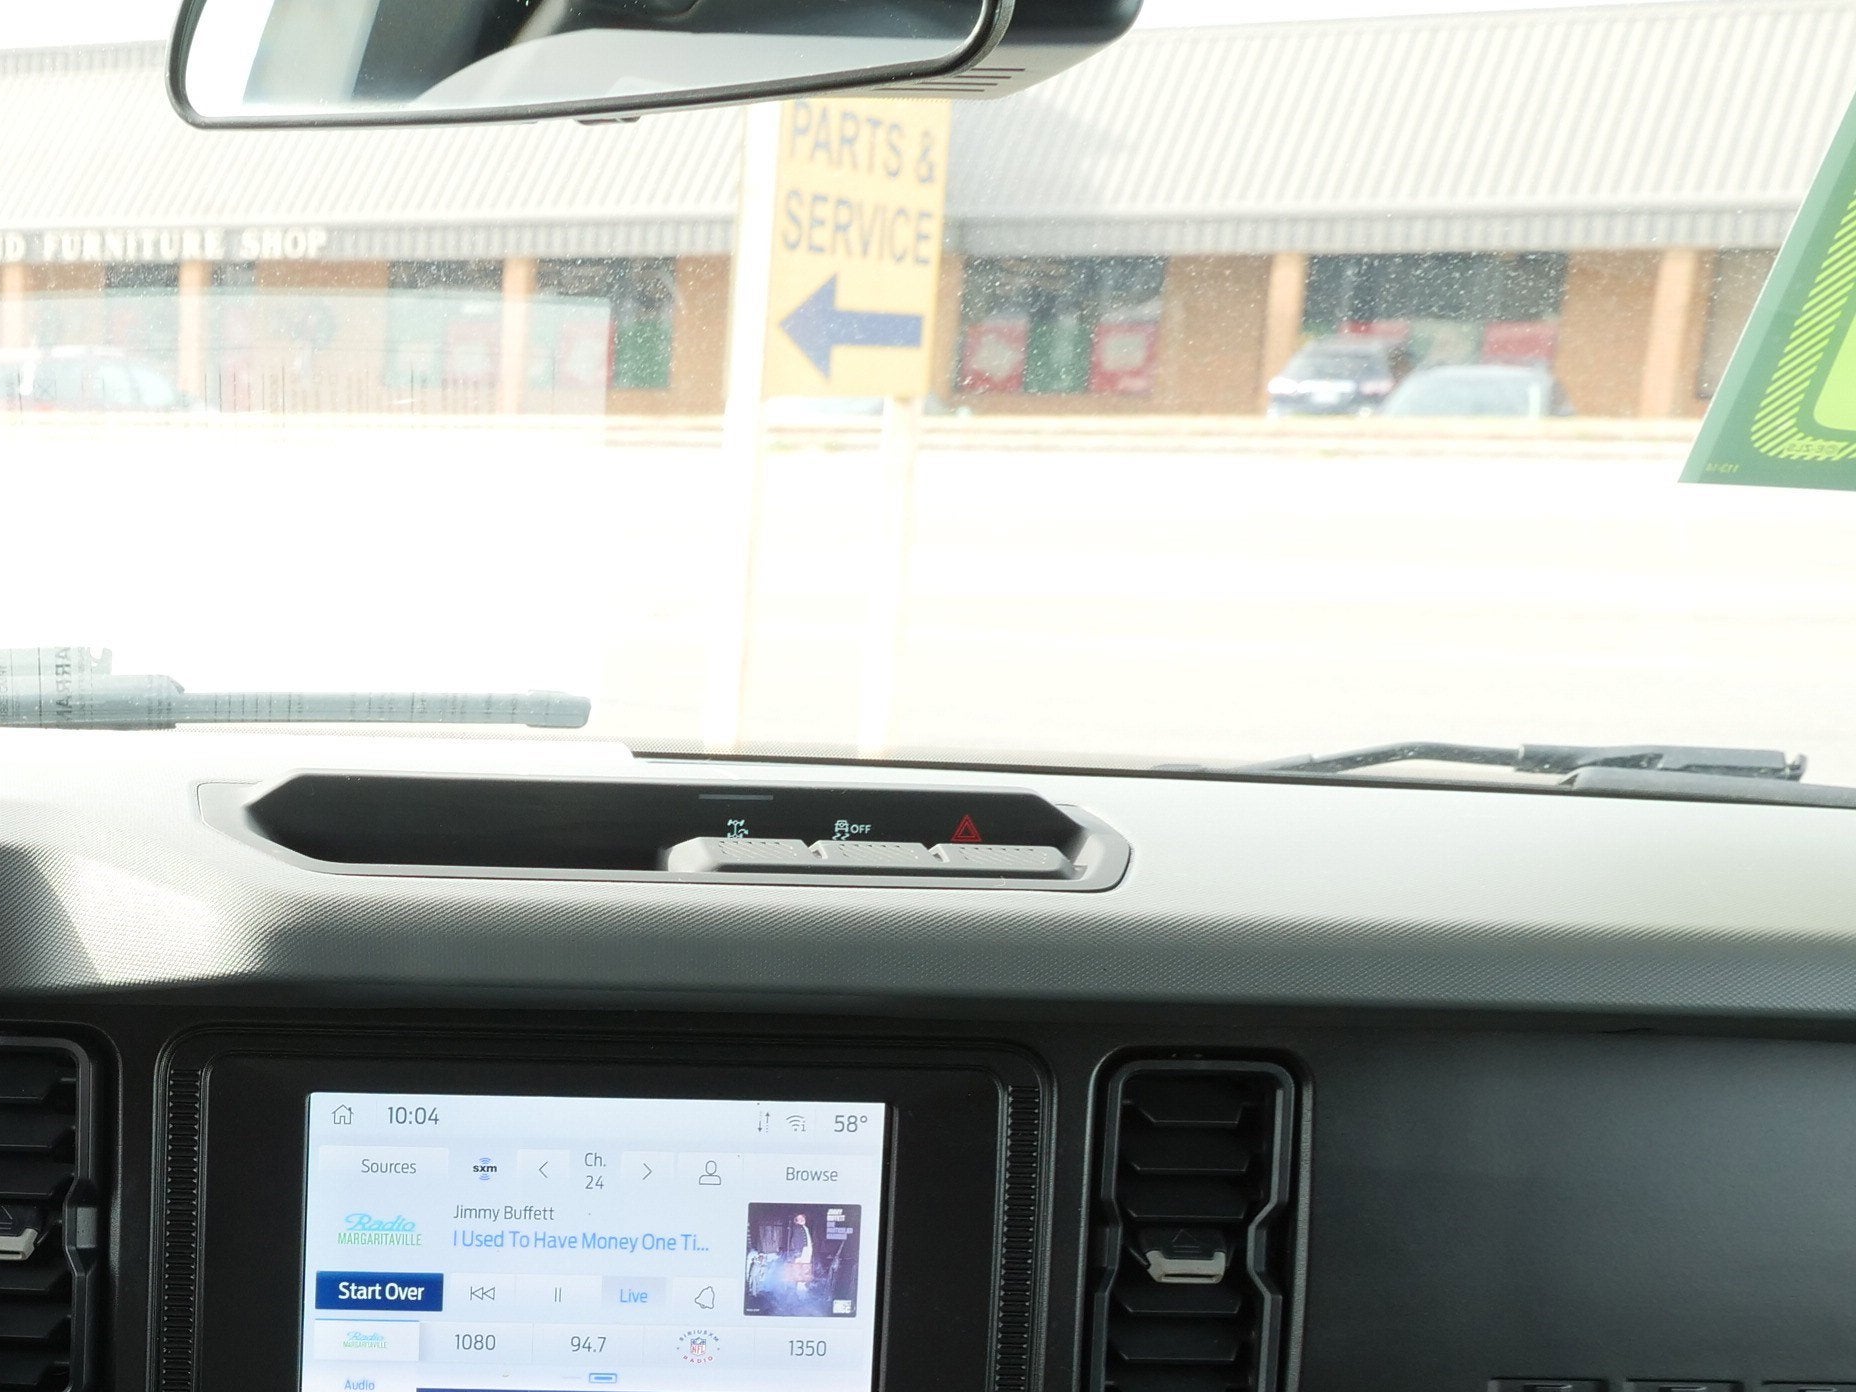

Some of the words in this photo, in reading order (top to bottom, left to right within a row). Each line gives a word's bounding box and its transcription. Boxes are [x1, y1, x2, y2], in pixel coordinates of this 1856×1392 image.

[789, 98, 904, 178] PARTS
[914, 132, 936, 184] &
[782, 188, 934, 266] SERVICE
[43, 230, 223, 260] FURNITURE
[240, 227, 326, 260] SHOP
[850, 824, 871, 834] OFF
[386, 1105, 440, 1126] 10:04
[834, 1113, 869, 1134] 58°
[360, 1158, 417, 1175] Sources
[472, 1164, 498, 1173] sxm
[584, 1152, 607, 1167] Ch.
[584, 1175, 605, 1190] 24
[785, 1166, 839, 1182] Browse
[344, 1212, 416, 1232] Radio
[453, 1205, 499, 1222] Jimmy
[504, 1205, 554, 1221] Buffett
[337, 1232, 423, 1246] MARGARITAVILLE
[462, 1230, 504, 1248] Used
[509, 1231, 530, 1248] To
[534, 1232, 577, 1249] Have
[581, 1232, 639, 1253] Money
[642, 1233, 677, 1251] One
[338, 1281, 381, 1300] Start
[384, 1282, 425, 1301] Over
[619, 1287, 648, 1304] Live
[454, 1333, 497, 1351] 1080
[570, 1335, 607, 1353] 94.7
[788, 1339, 827, 1357] 1350
[344, 1378, 375, 1391] Audio
